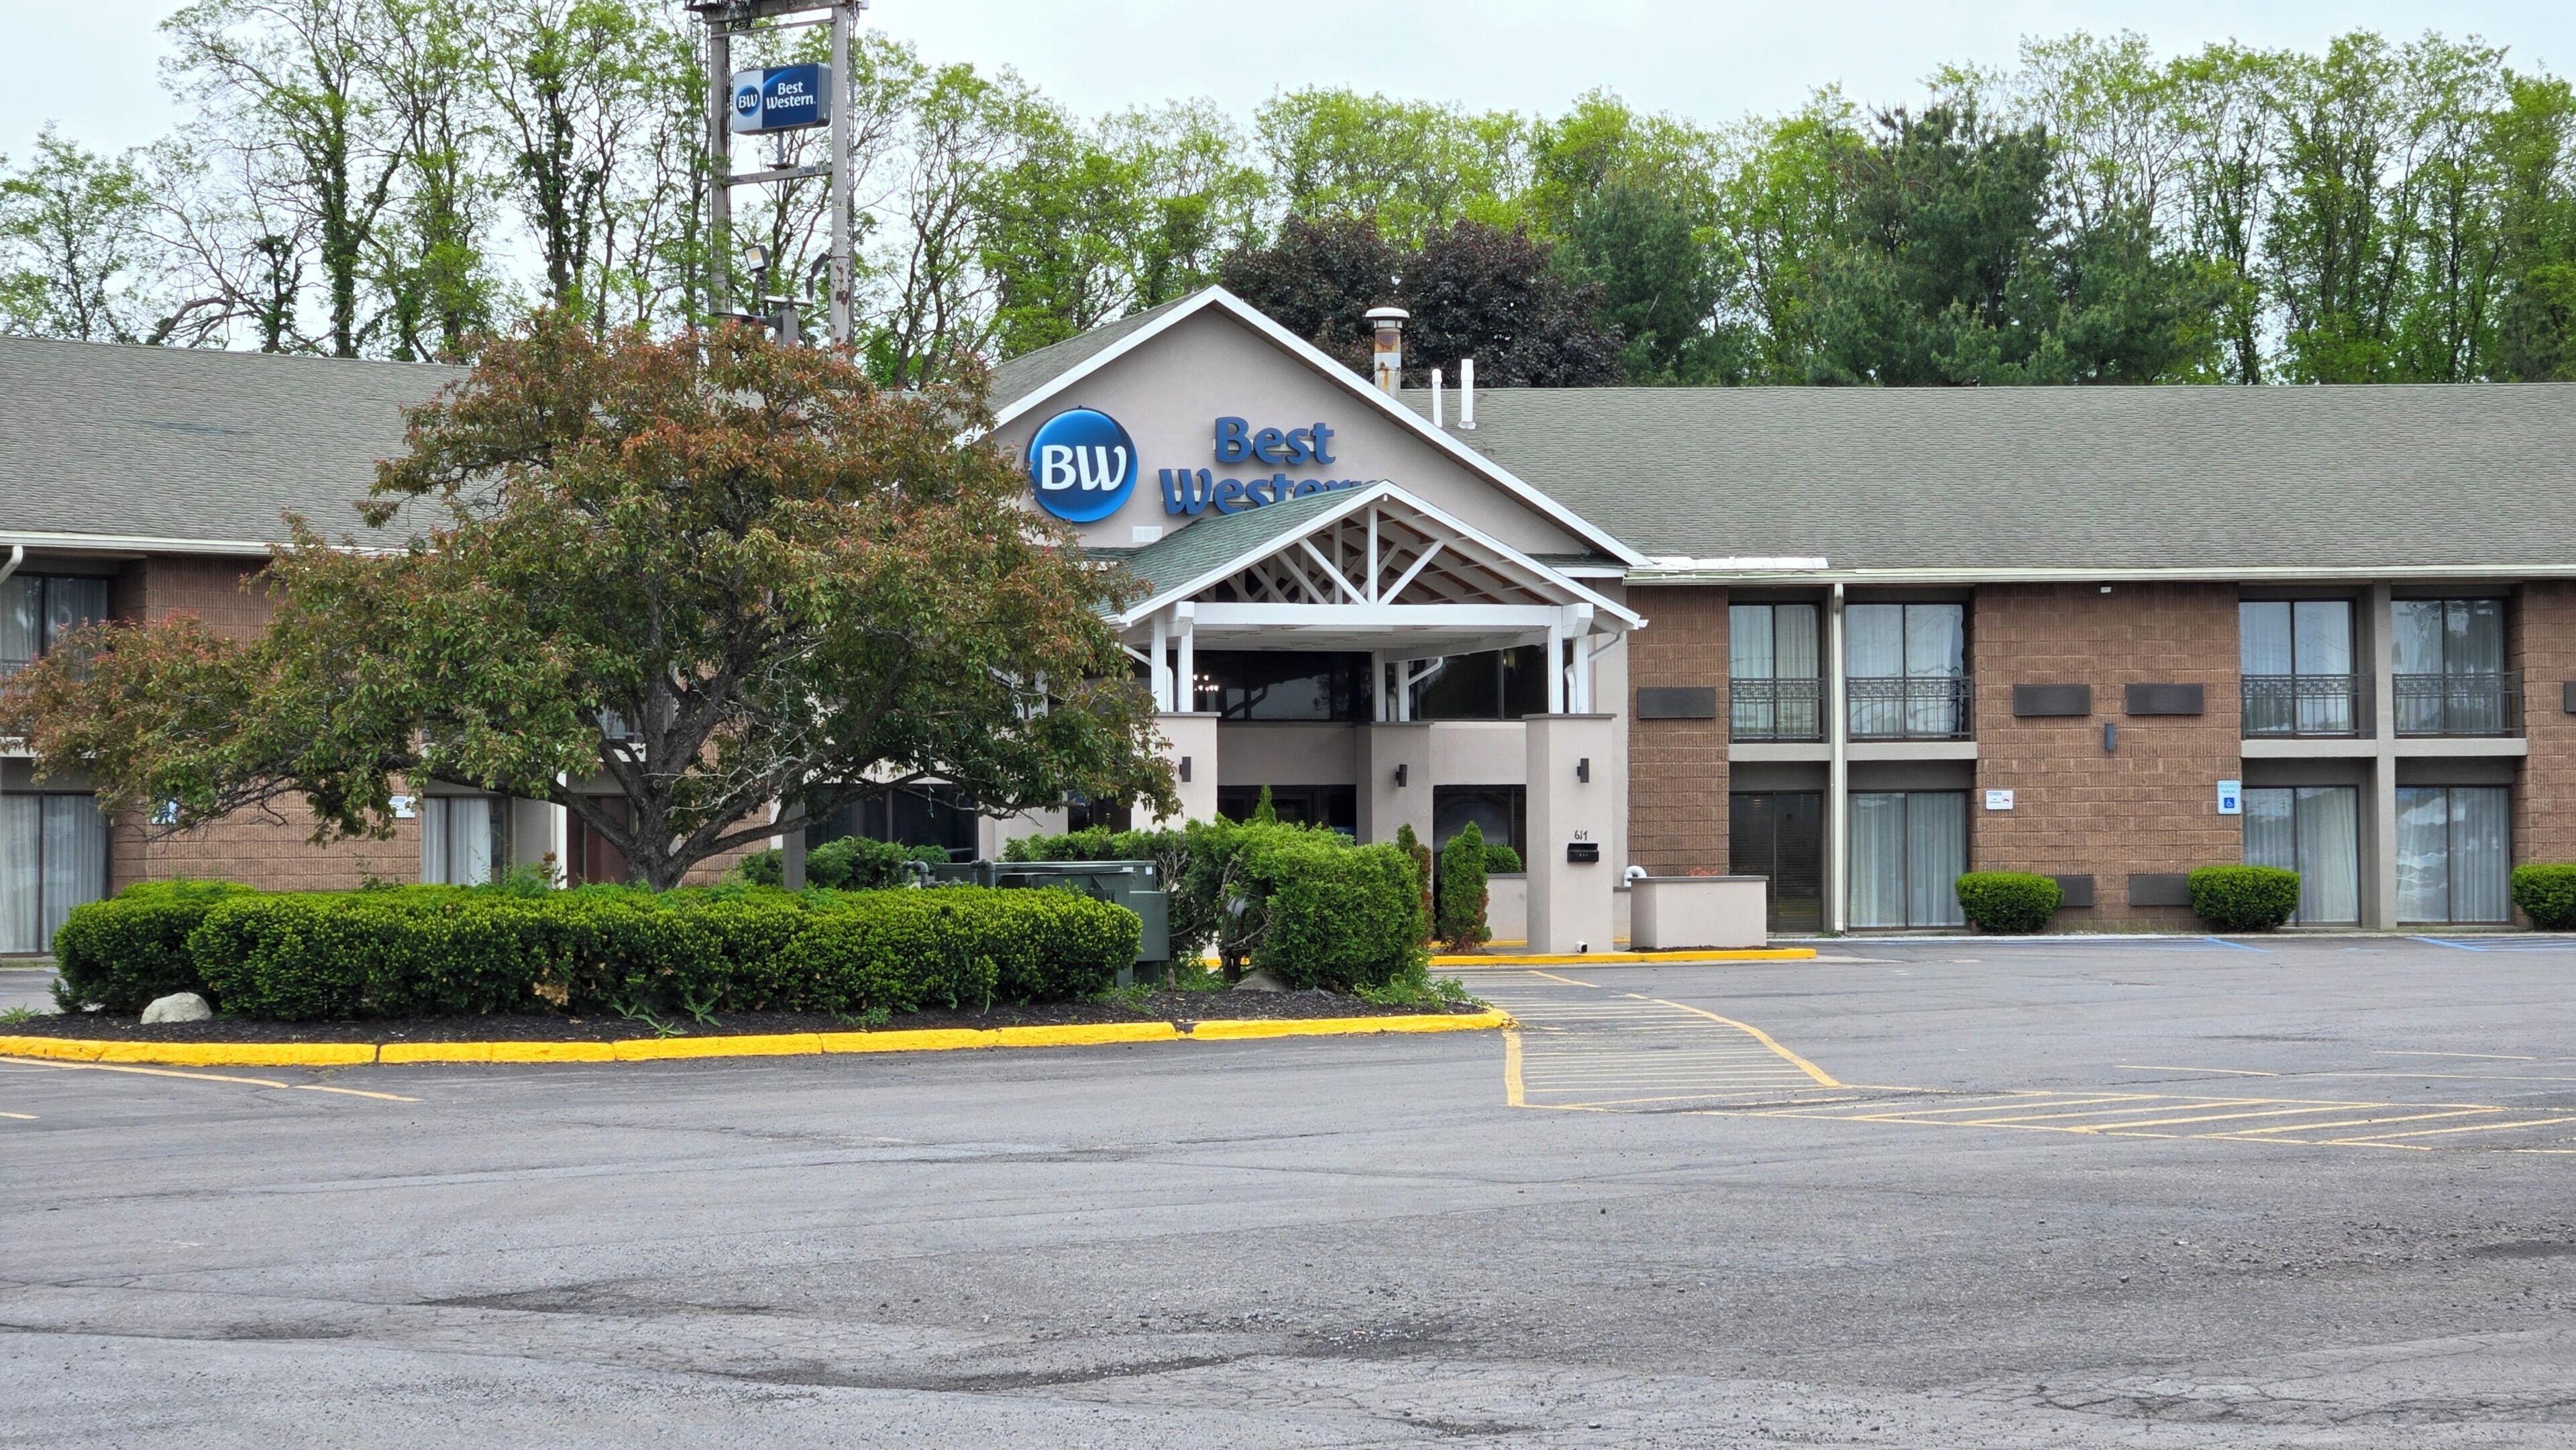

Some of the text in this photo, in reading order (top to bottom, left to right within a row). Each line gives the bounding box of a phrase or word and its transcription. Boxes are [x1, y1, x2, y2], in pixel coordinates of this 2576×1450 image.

[739, 94, 757, 109] BW
[778, 81, 803, 95] Best
[1214, 416, 1336, 465] Best
[1041, 444, 1127, 491] BW
